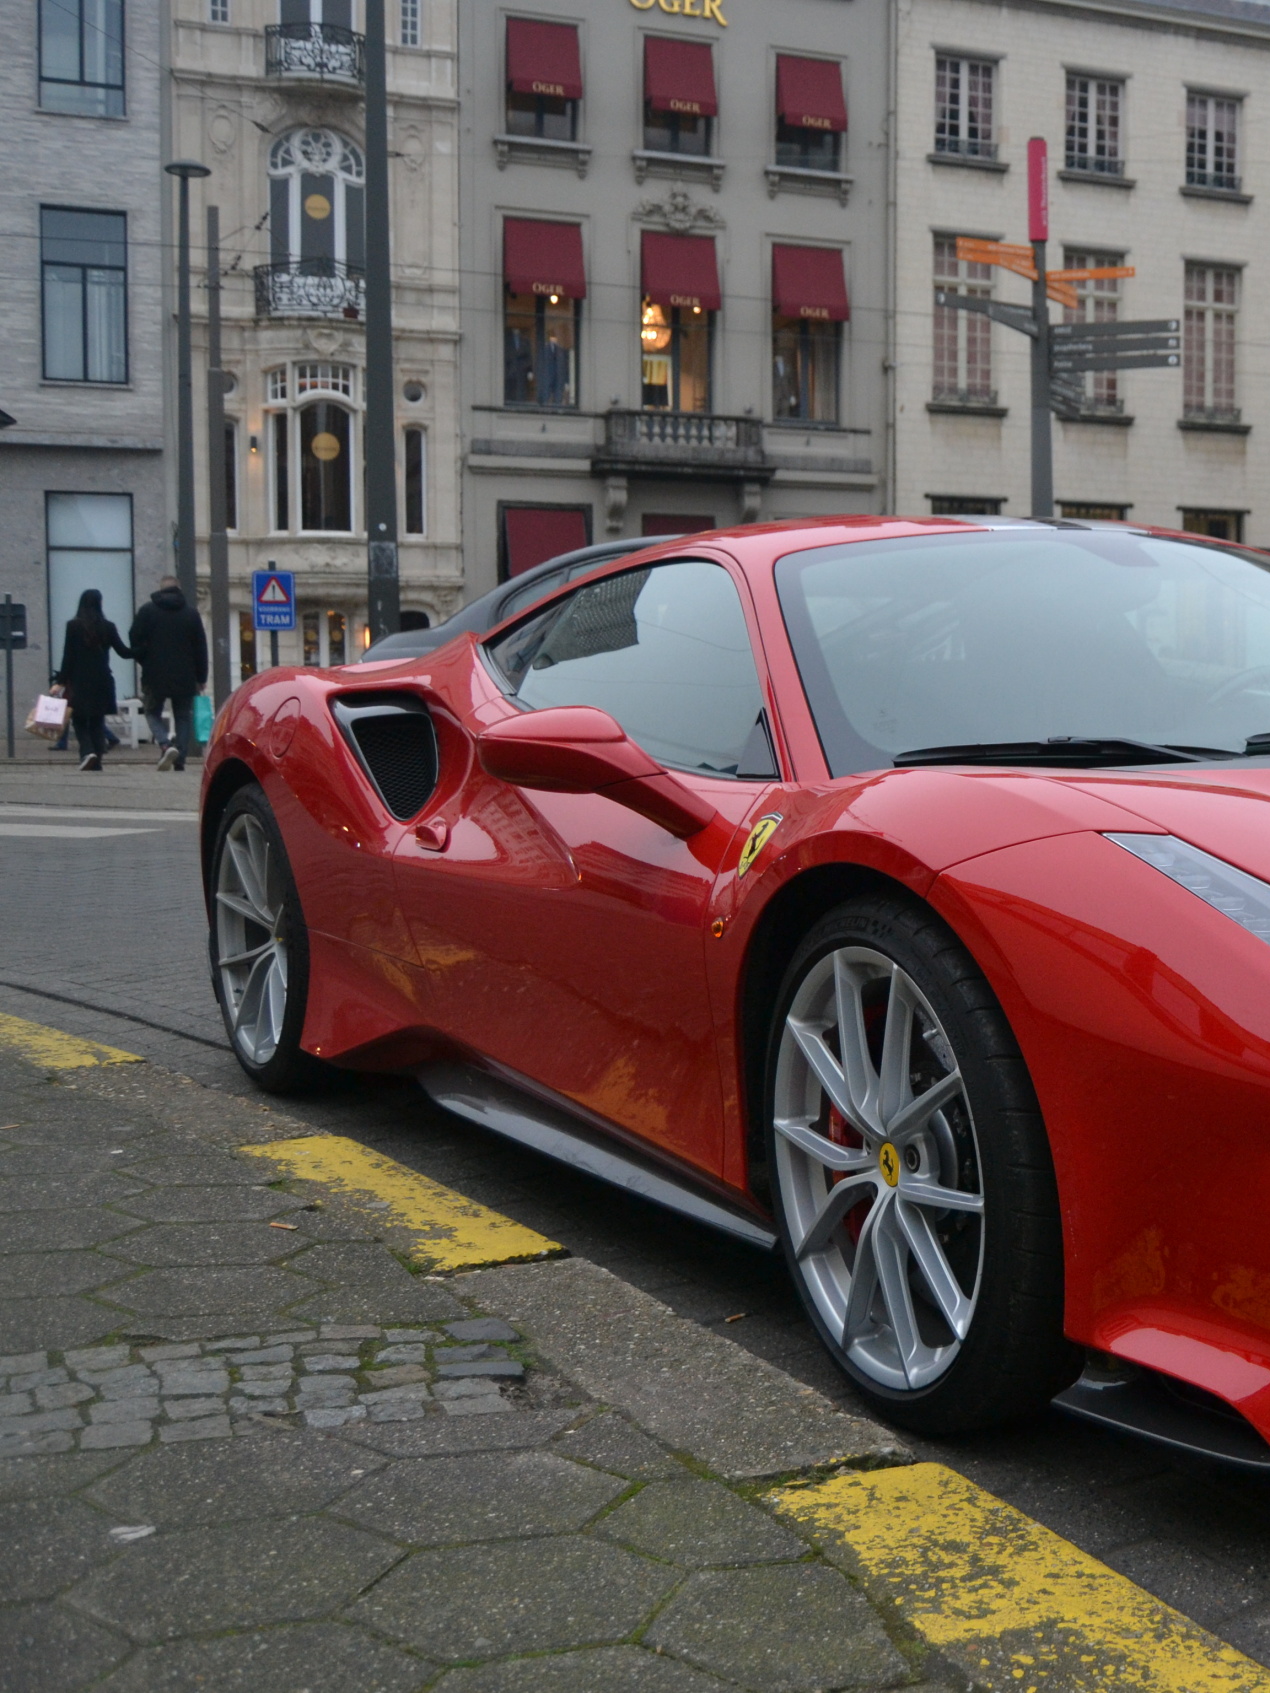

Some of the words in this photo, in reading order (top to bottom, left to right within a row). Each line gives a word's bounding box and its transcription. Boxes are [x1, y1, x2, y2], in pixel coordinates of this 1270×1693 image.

[532, 81, 565, 96] OGER
[670, 99, 701, 113] OGER
[802, 114, 832, 129] OGER
[532, 282, 565, 296] OGER
[670, 294, 700, 307] OGER
[800, 305, 829, 319] OGER
[260, 614, 290, 625] TRAM
